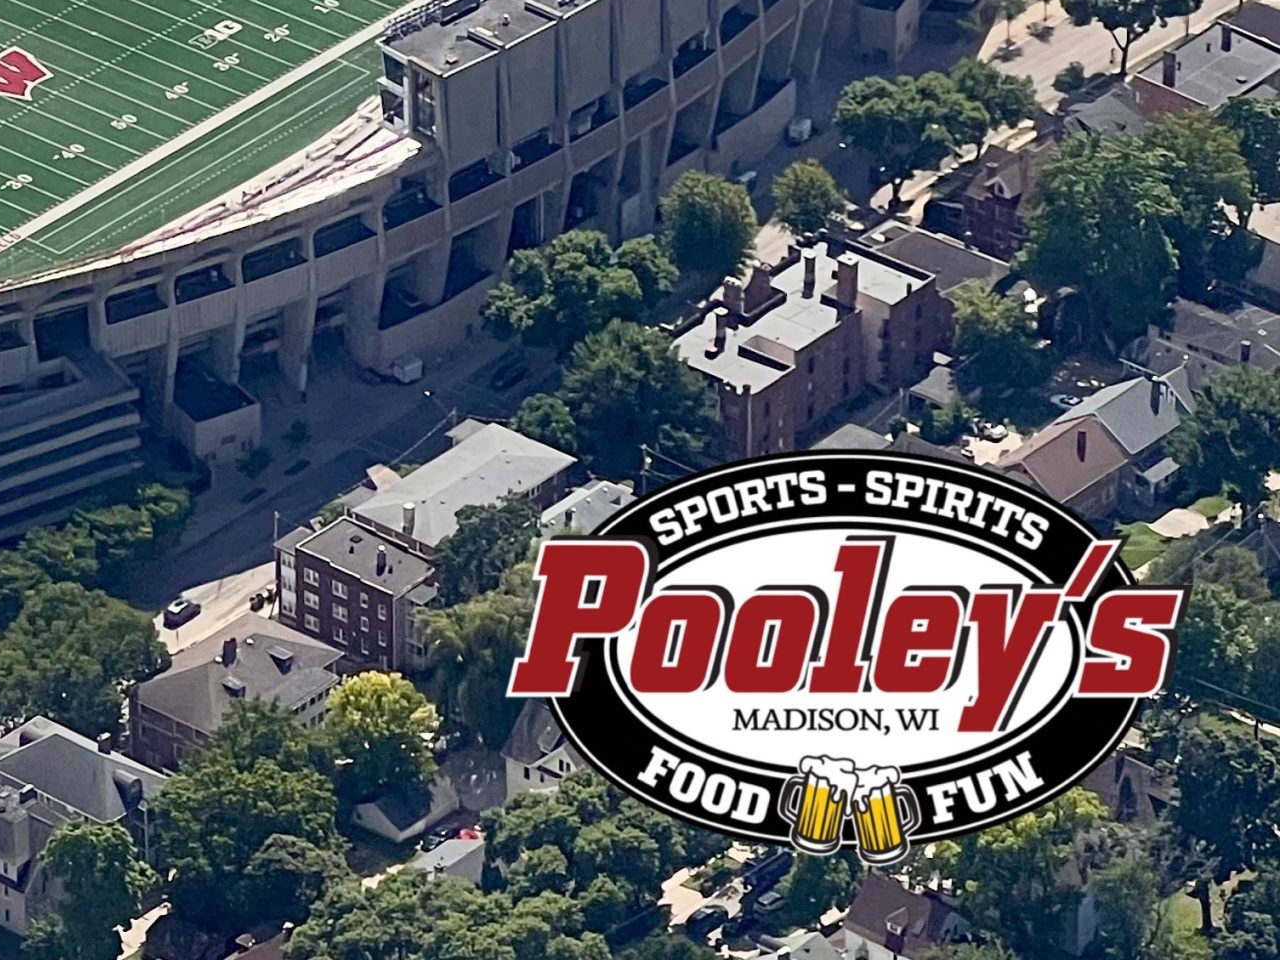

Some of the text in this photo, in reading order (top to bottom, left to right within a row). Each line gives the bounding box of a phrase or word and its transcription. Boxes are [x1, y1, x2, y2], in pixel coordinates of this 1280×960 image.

[263, 26, 290, 43] 20
[213, 54, 240, 71] 30
[165, 83, 189, 100] 40
[110, 114, 138, 130] 50
[62, 143, 86, 159] 40
[7, 174, 33, 190] 30
